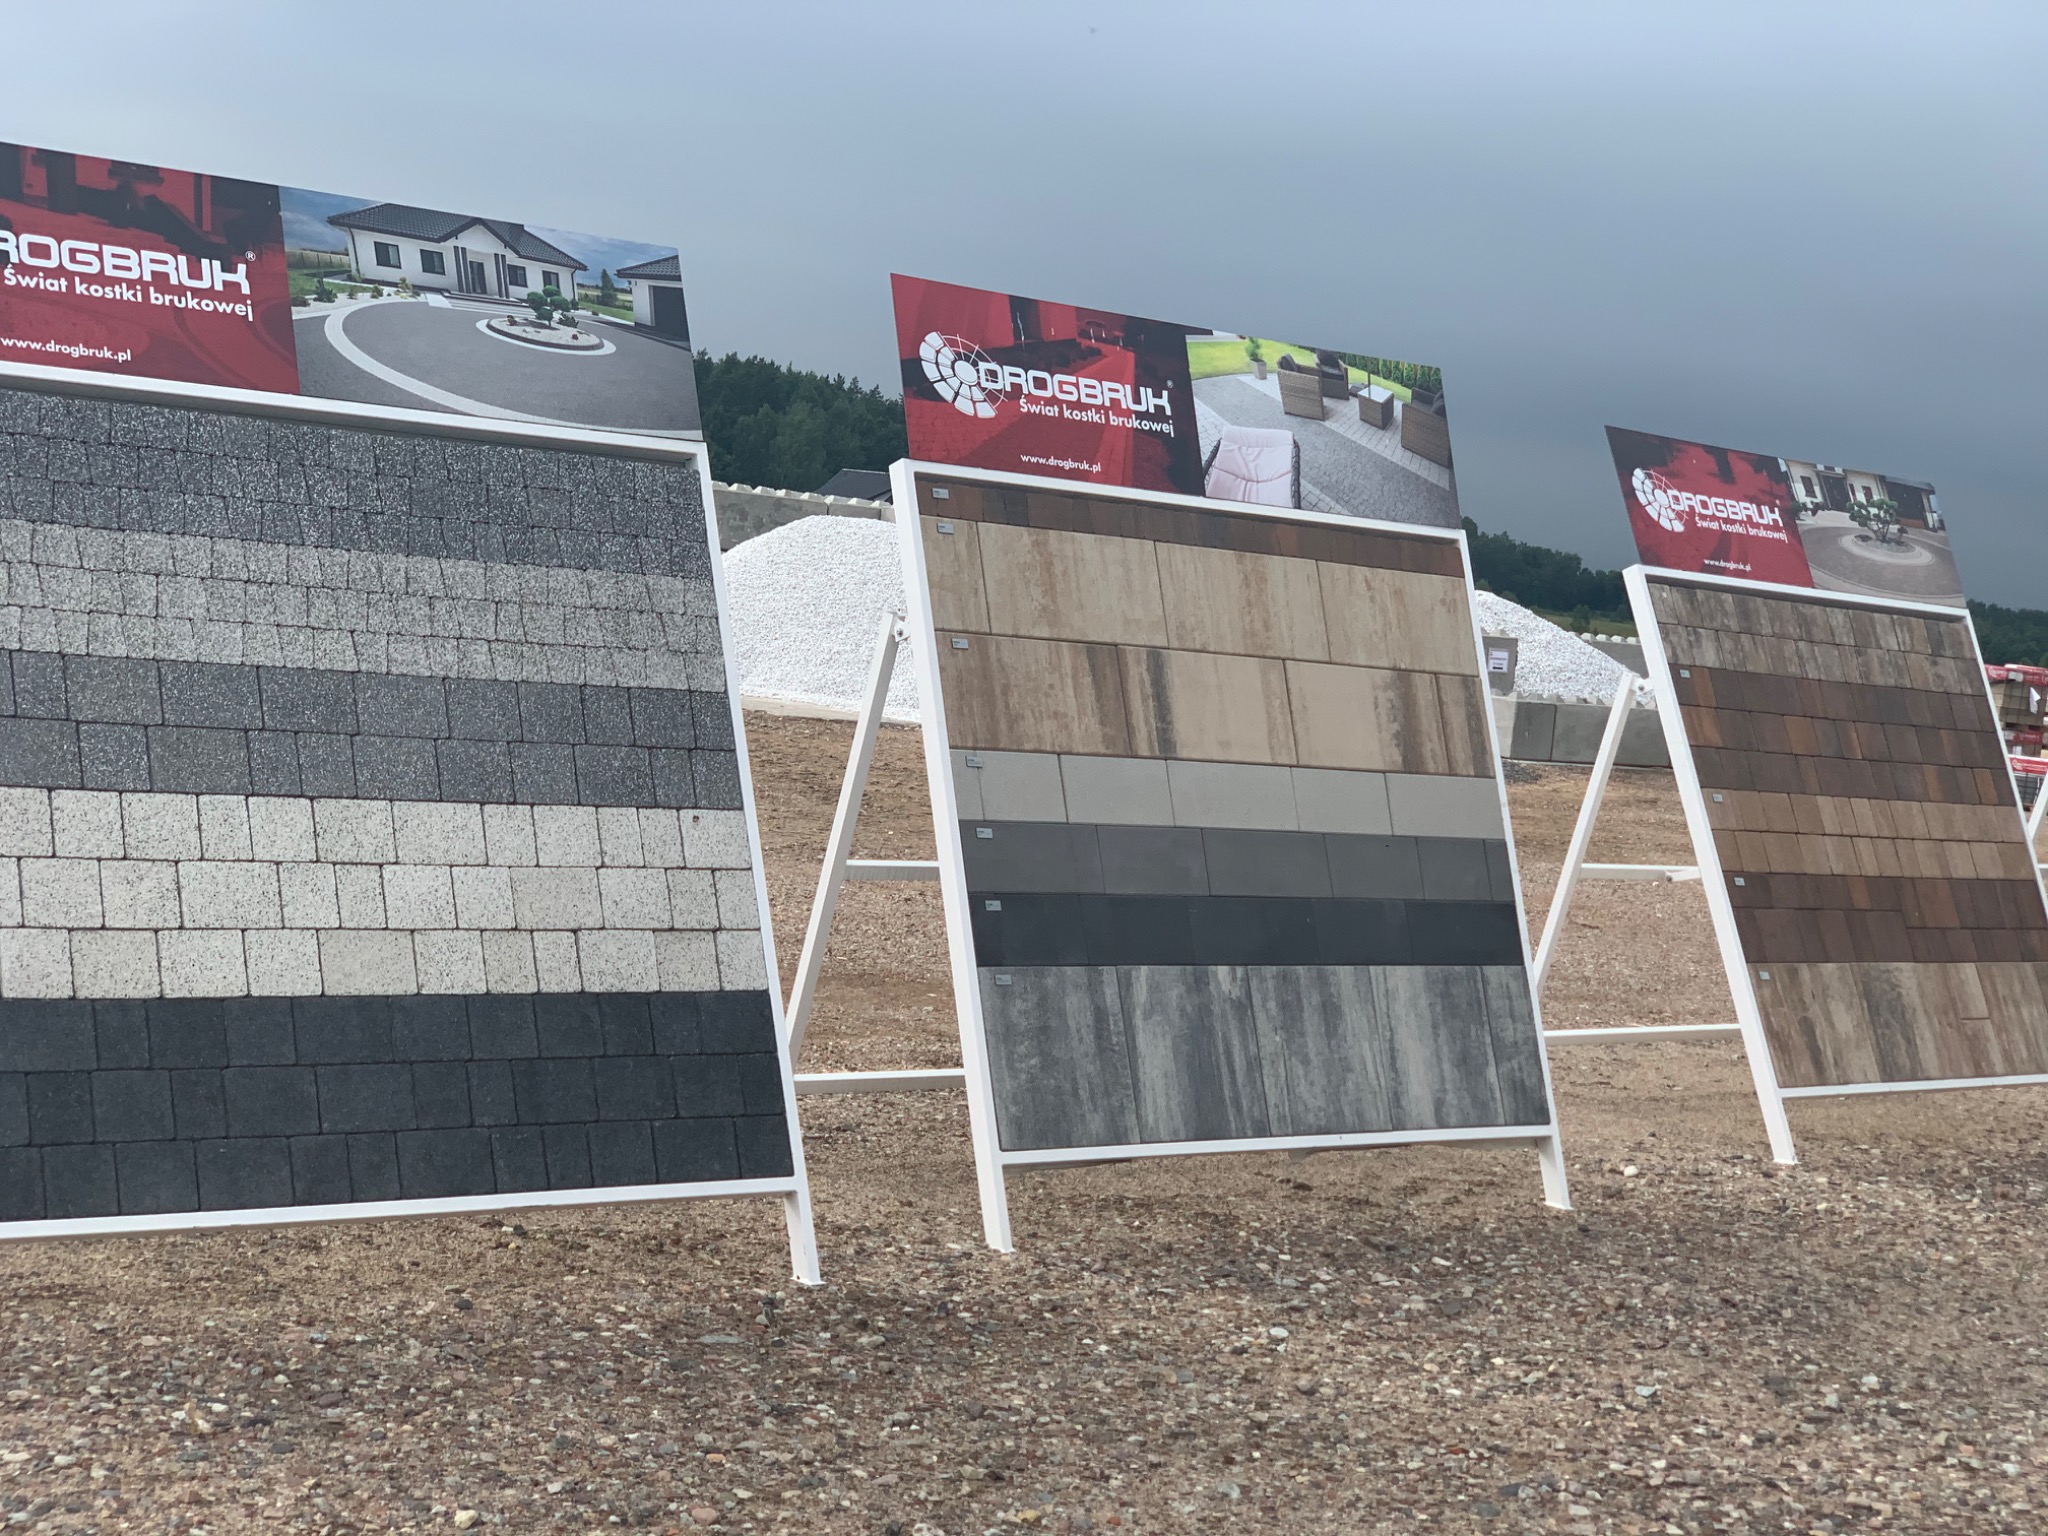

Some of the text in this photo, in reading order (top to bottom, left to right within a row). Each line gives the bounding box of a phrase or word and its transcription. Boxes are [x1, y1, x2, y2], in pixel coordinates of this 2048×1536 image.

[3, 264, 254, 322] Świat kostki brukowej
[0, 337, 132, 363] www.drogbruk.pl
[977, 362, 1172, 415] DROGBRUK
[1020, 394, 1174, 437] Świat kostki brukowej
[1020, 454, 1101, 473] www.drogbruk.pl
[1667, 489, 1783, 527] DROGBRUK
[1696, 514, 1789, 543] Świat kostki brukowej
[1704, 559, 1752, 572] www.drogbruk.pl
